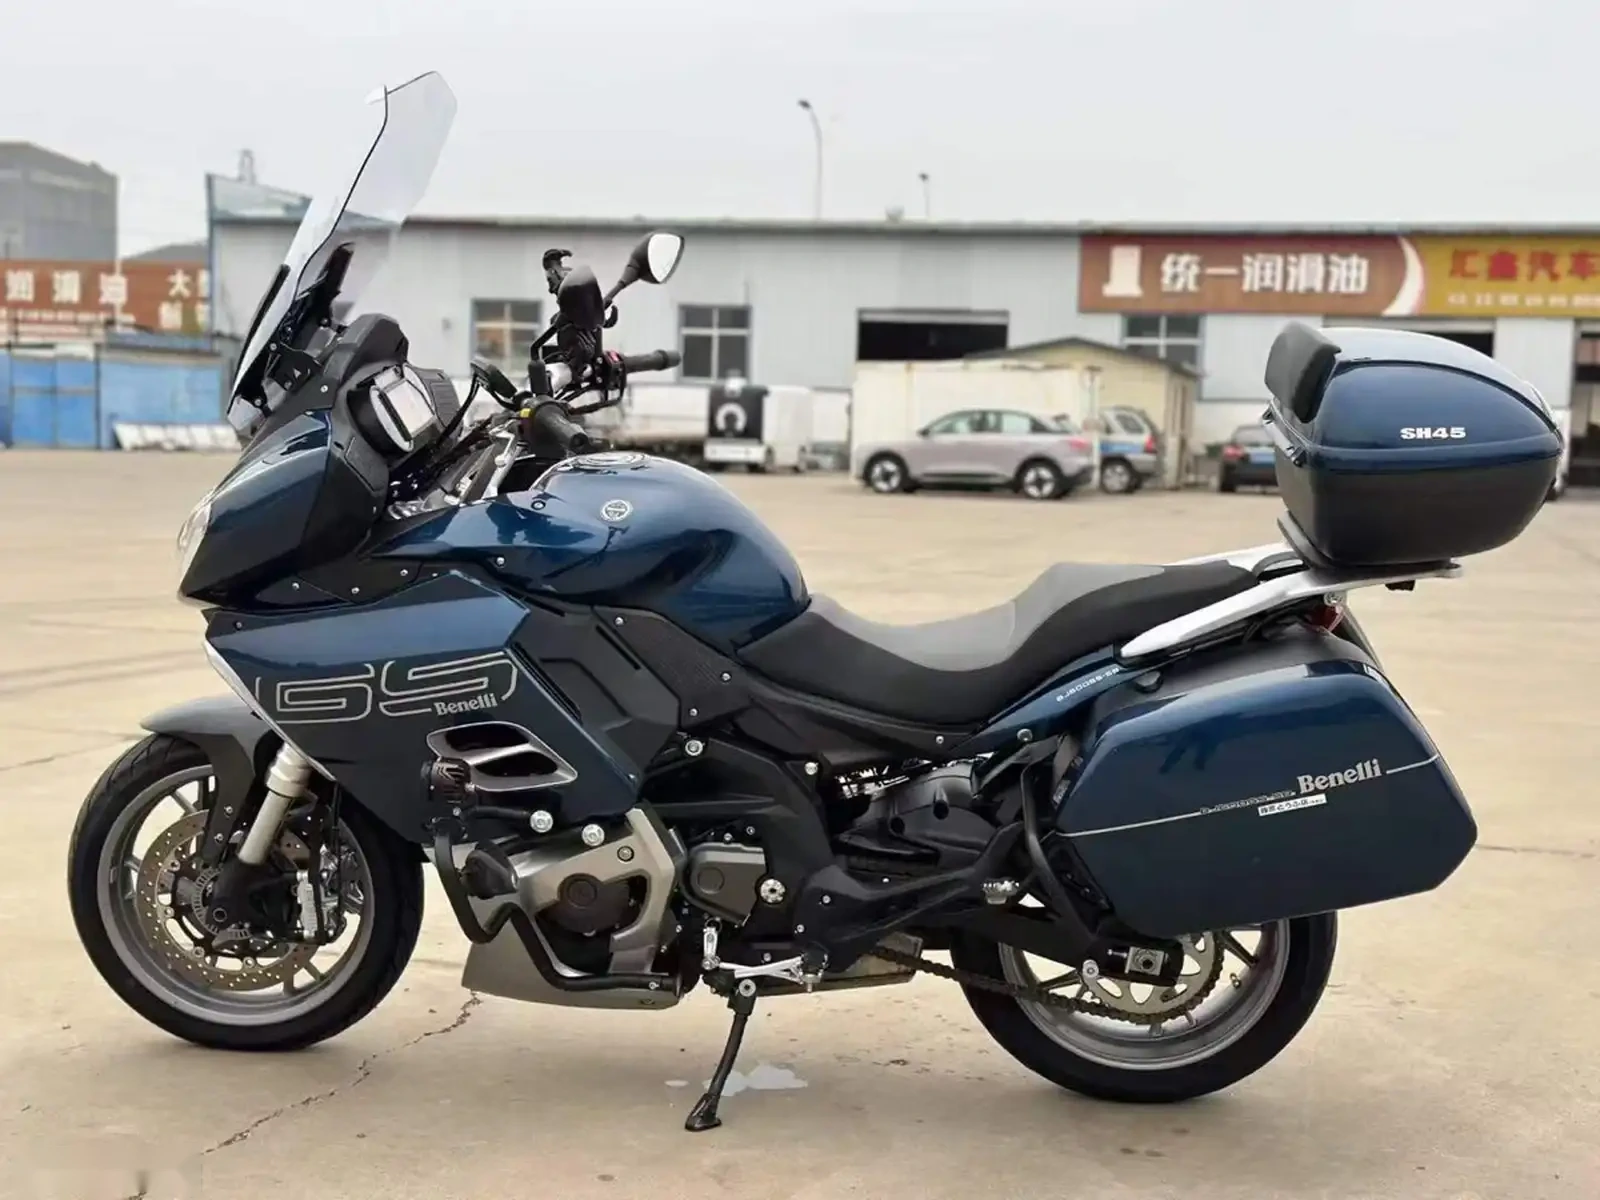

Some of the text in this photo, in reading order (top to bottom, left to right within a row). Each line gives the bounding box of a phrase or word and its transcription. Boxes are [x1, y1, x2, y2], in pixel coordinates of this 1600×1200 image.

[1161, 253, 1369, 293] 统一润滑油
[1400, 426, 1467, 440] SH45
[433, 692, 498, 716] Benelli
[1297, 758, 1382, 794] Benelli
